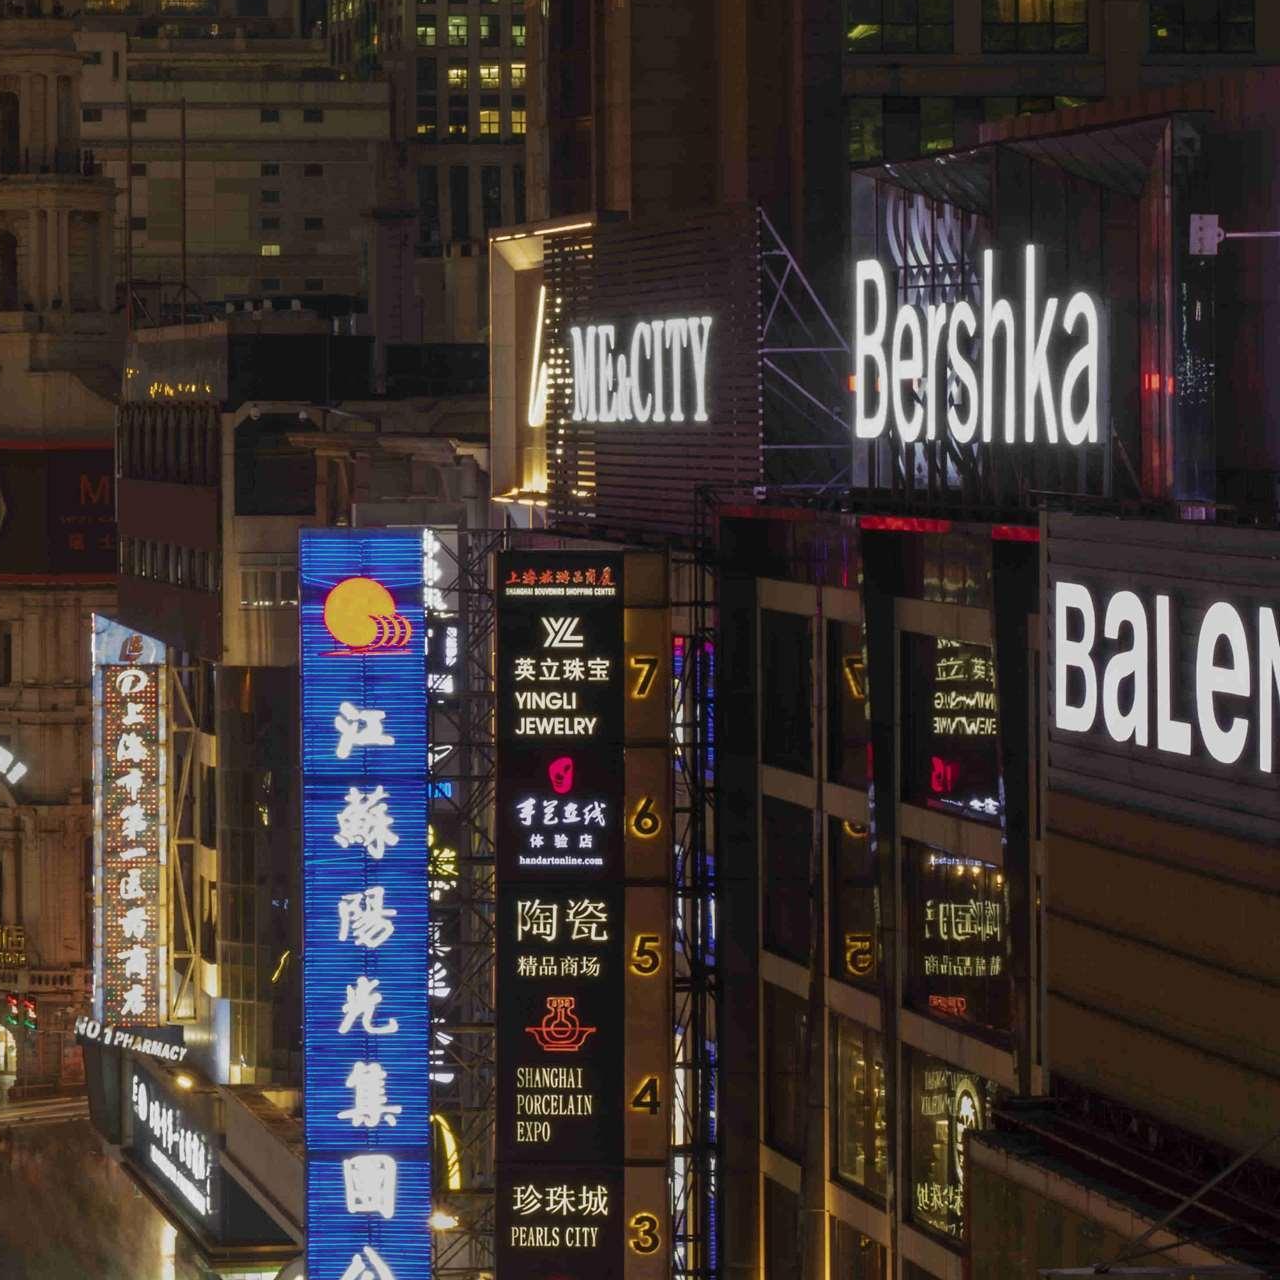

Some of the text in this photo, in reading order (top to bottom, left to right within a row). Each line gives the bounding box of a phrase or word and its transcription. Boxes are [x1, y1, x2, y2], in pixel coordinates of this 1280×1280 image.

[855, 244, 1098, 446] Bershka
[594, 587, 616, 596] CENTER
[514, 657, 610, 682] 英立珠宝
[631, 656, 660, 699] 7
[514, 691, 577, 711] YINGLI
[514, 717, 598, 736] JEWELRY
[632, 795, 661, 840] 6
[529, 833, 594, 849] 体验店
[519, 854, 604, 866] handartonline.com
[516, 898, 610, 943] 陶瓷
[517, 955, 601, 978] 精品商场
[631, 935, 661, 975] 5
[113, 1031, 188, 1062] PHARMACY
[516, 1067, 584, 1089] SHANGHAI
[516, 1094, 593, 1116] PORCELAIN
[631, 1077, 661, 1116] 4
[516, 1120, 551, 1143] EXPO
[512, 1184, 609, 1217] 珍珠城
[511, 1226, 599, 1248] PEARLS CITY
[630, 1213, 661, 1254] 3
